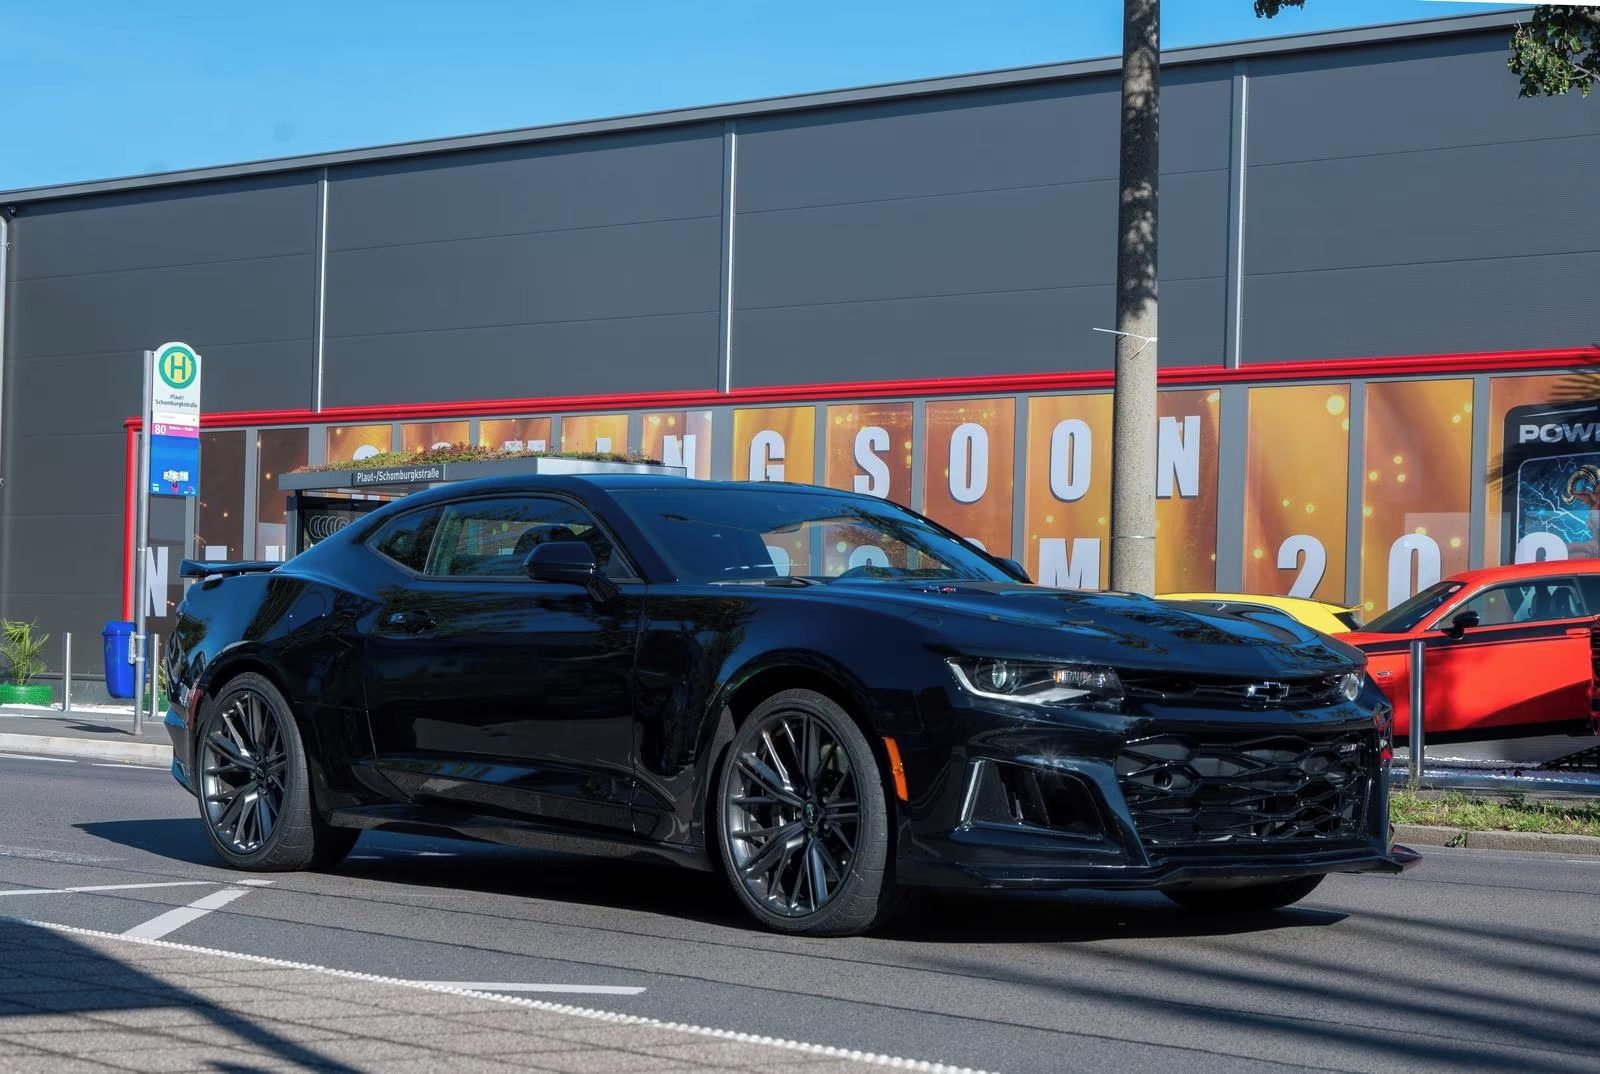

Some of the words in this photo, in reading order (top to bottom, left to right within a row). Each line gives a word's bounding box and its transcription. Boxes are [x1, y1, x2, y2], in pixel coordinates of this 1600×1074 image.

[170, 354, 186, 380] H
[154, 424, 167, 434] 80
[357, 468, 440, 482] Plaut-/Schomburgkstraße
